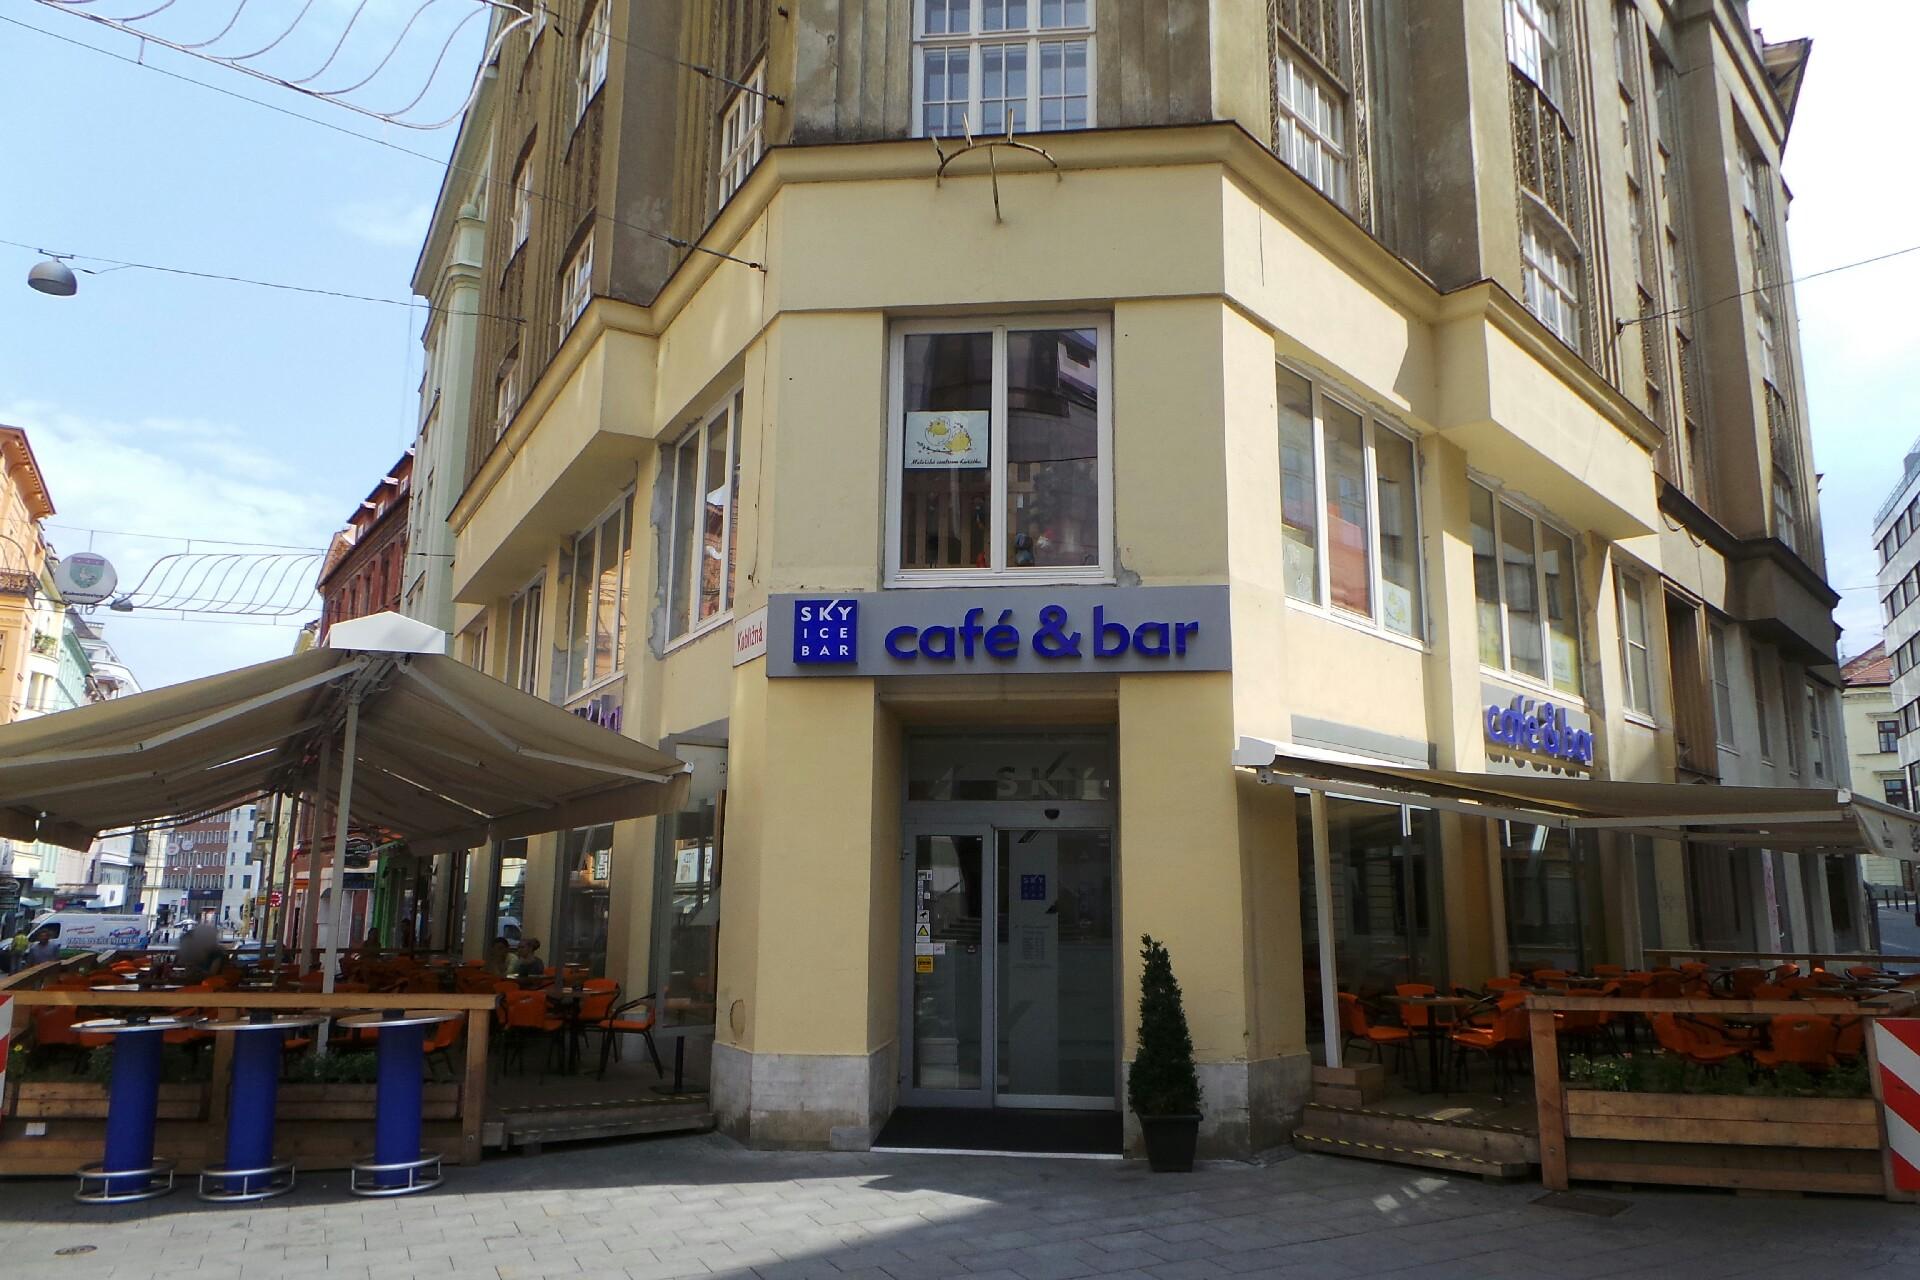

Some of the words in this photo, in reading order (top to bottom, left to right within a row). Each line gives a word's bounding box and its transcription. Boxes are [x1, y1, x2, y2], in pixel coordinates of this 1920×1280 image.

[800, 600, 853, 622] SKY
[737, 622, 763, 652] Kobližná
[803, 627, 849, 639] ICE
[885, 607, 1020, 660] café
[1032, 605, 1082, 658] &
[1093, 605, 1199, 658] bar
[801, 645, 849, 656] BAR
[1487, 695, 1539, 749] café
[1556, 708, 1592, 761] bar
[996, 751, 1098, 799] SKY
